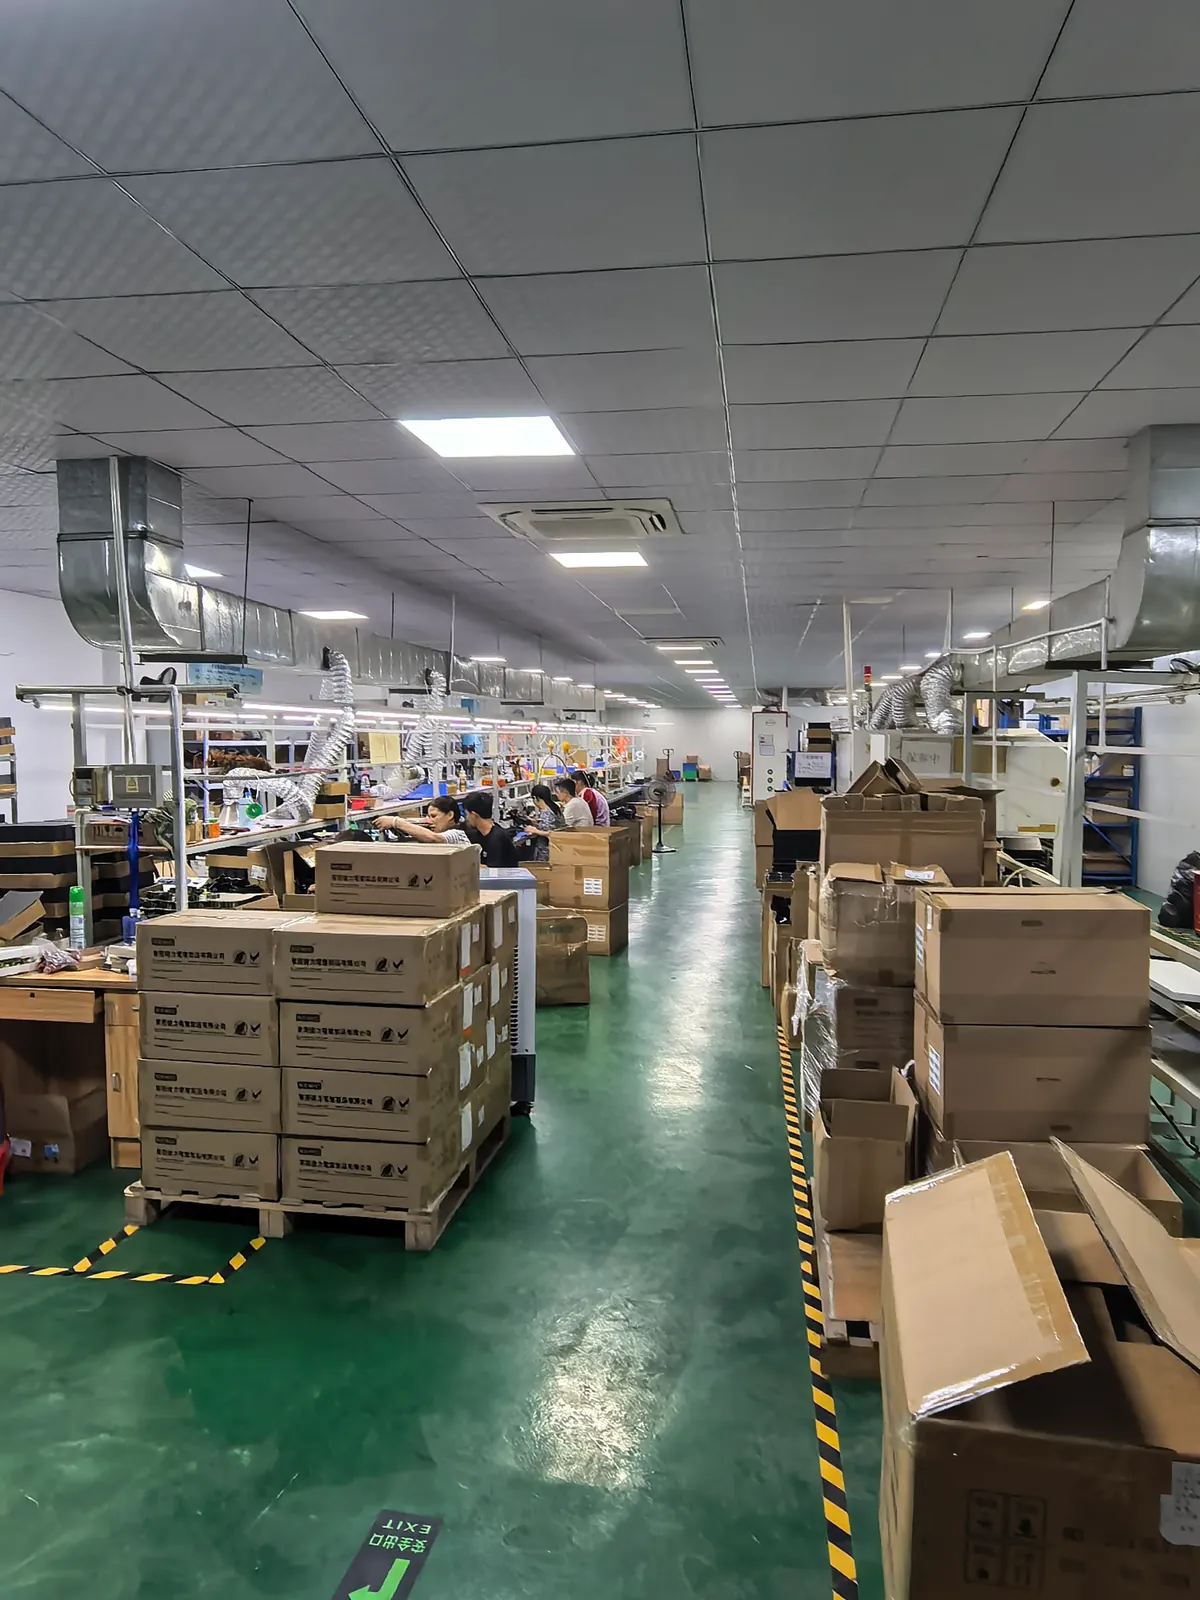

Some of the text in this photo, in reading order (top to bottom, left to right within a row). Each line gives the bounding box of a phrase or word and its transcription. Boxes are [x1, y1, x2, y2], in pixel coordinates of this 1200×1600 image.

[382, 1519, 431, 1534] EXIT
[369, 1533, 427, 1553] 安全出口
